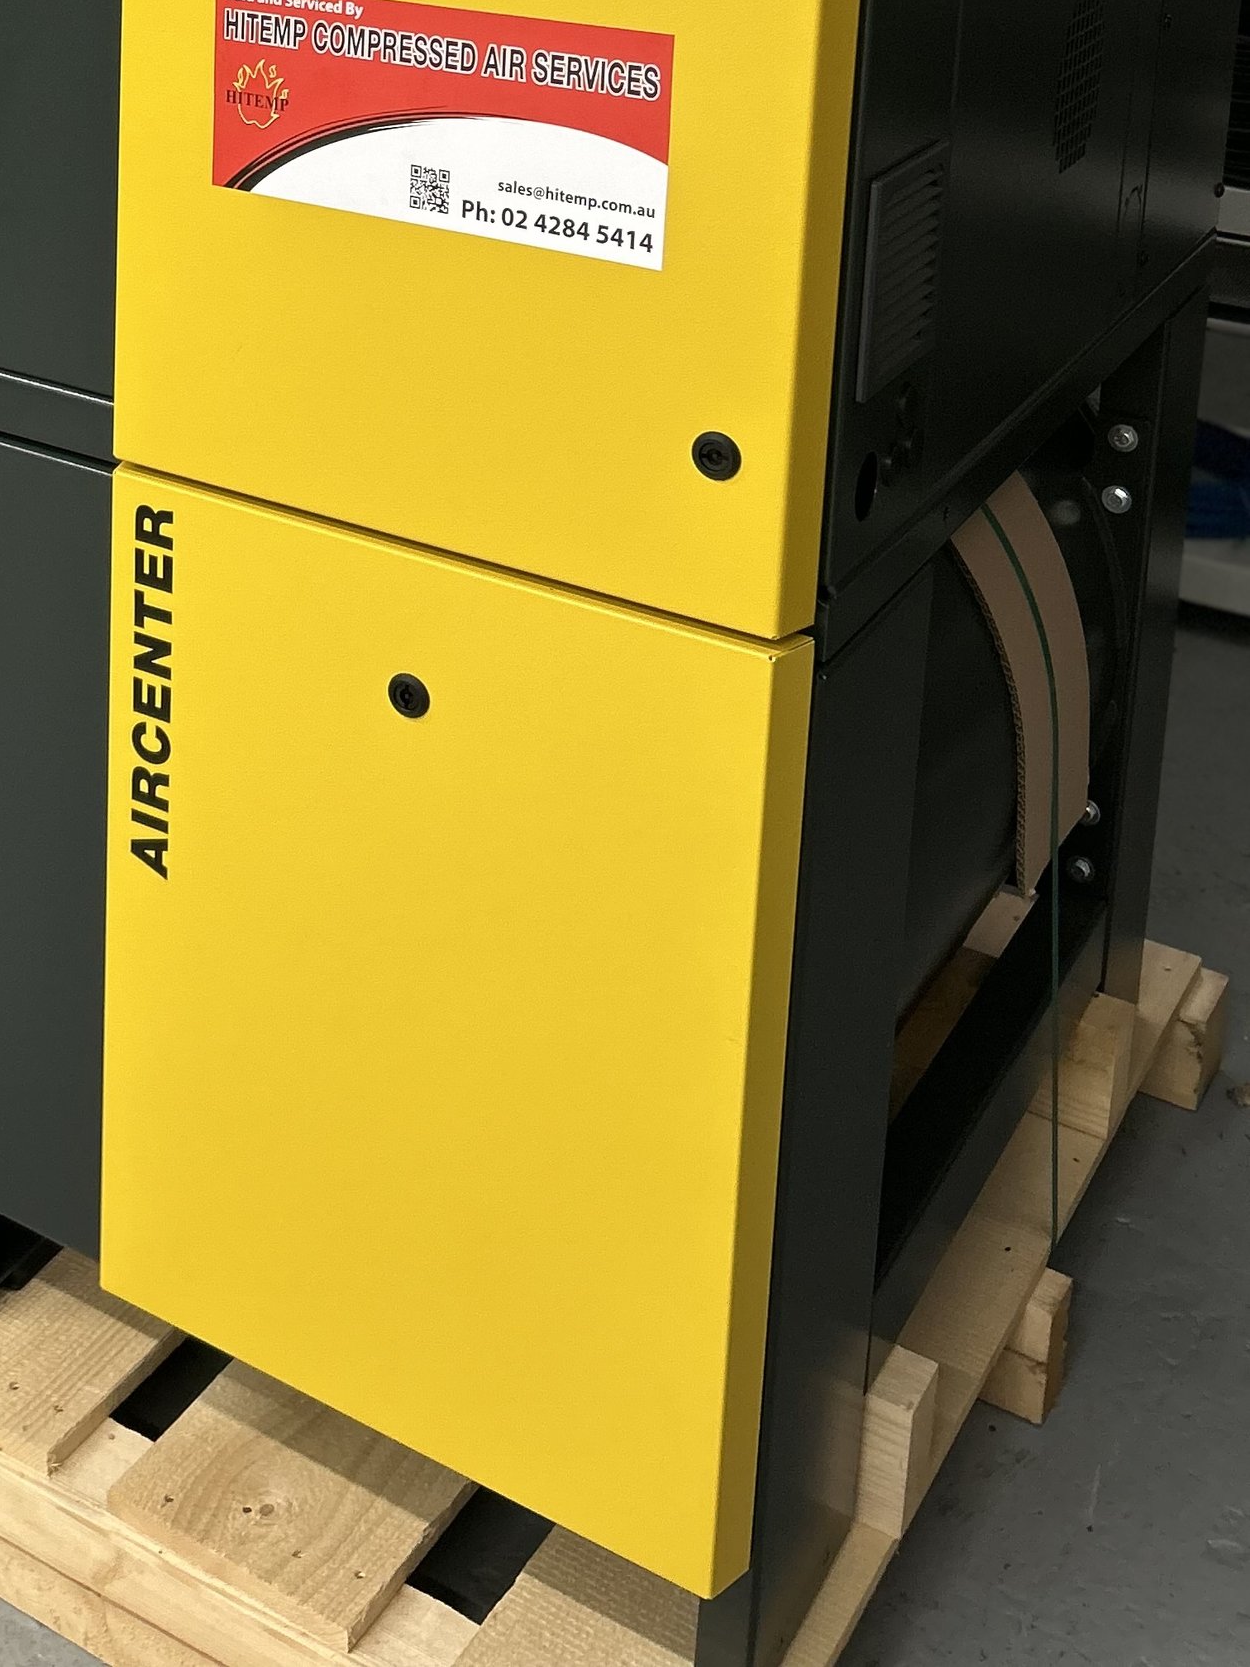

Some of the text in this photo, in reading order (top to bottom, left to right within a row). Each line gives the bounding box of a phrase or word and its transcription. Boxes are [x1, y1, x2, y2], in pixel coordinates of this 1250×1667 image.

[345, 1, 363, 19] By
[223, 8, 661, 101] HITEMP COMPRESSED AIR SERVICES
[226, 88, 289, 112] HITEMP
[498, 179, 656, 219] sales@hitemp.com.au
[461, 199, 654, 253] Ph: 02 4284 5414
[131, 504, 174, 881] AIRCENTER
